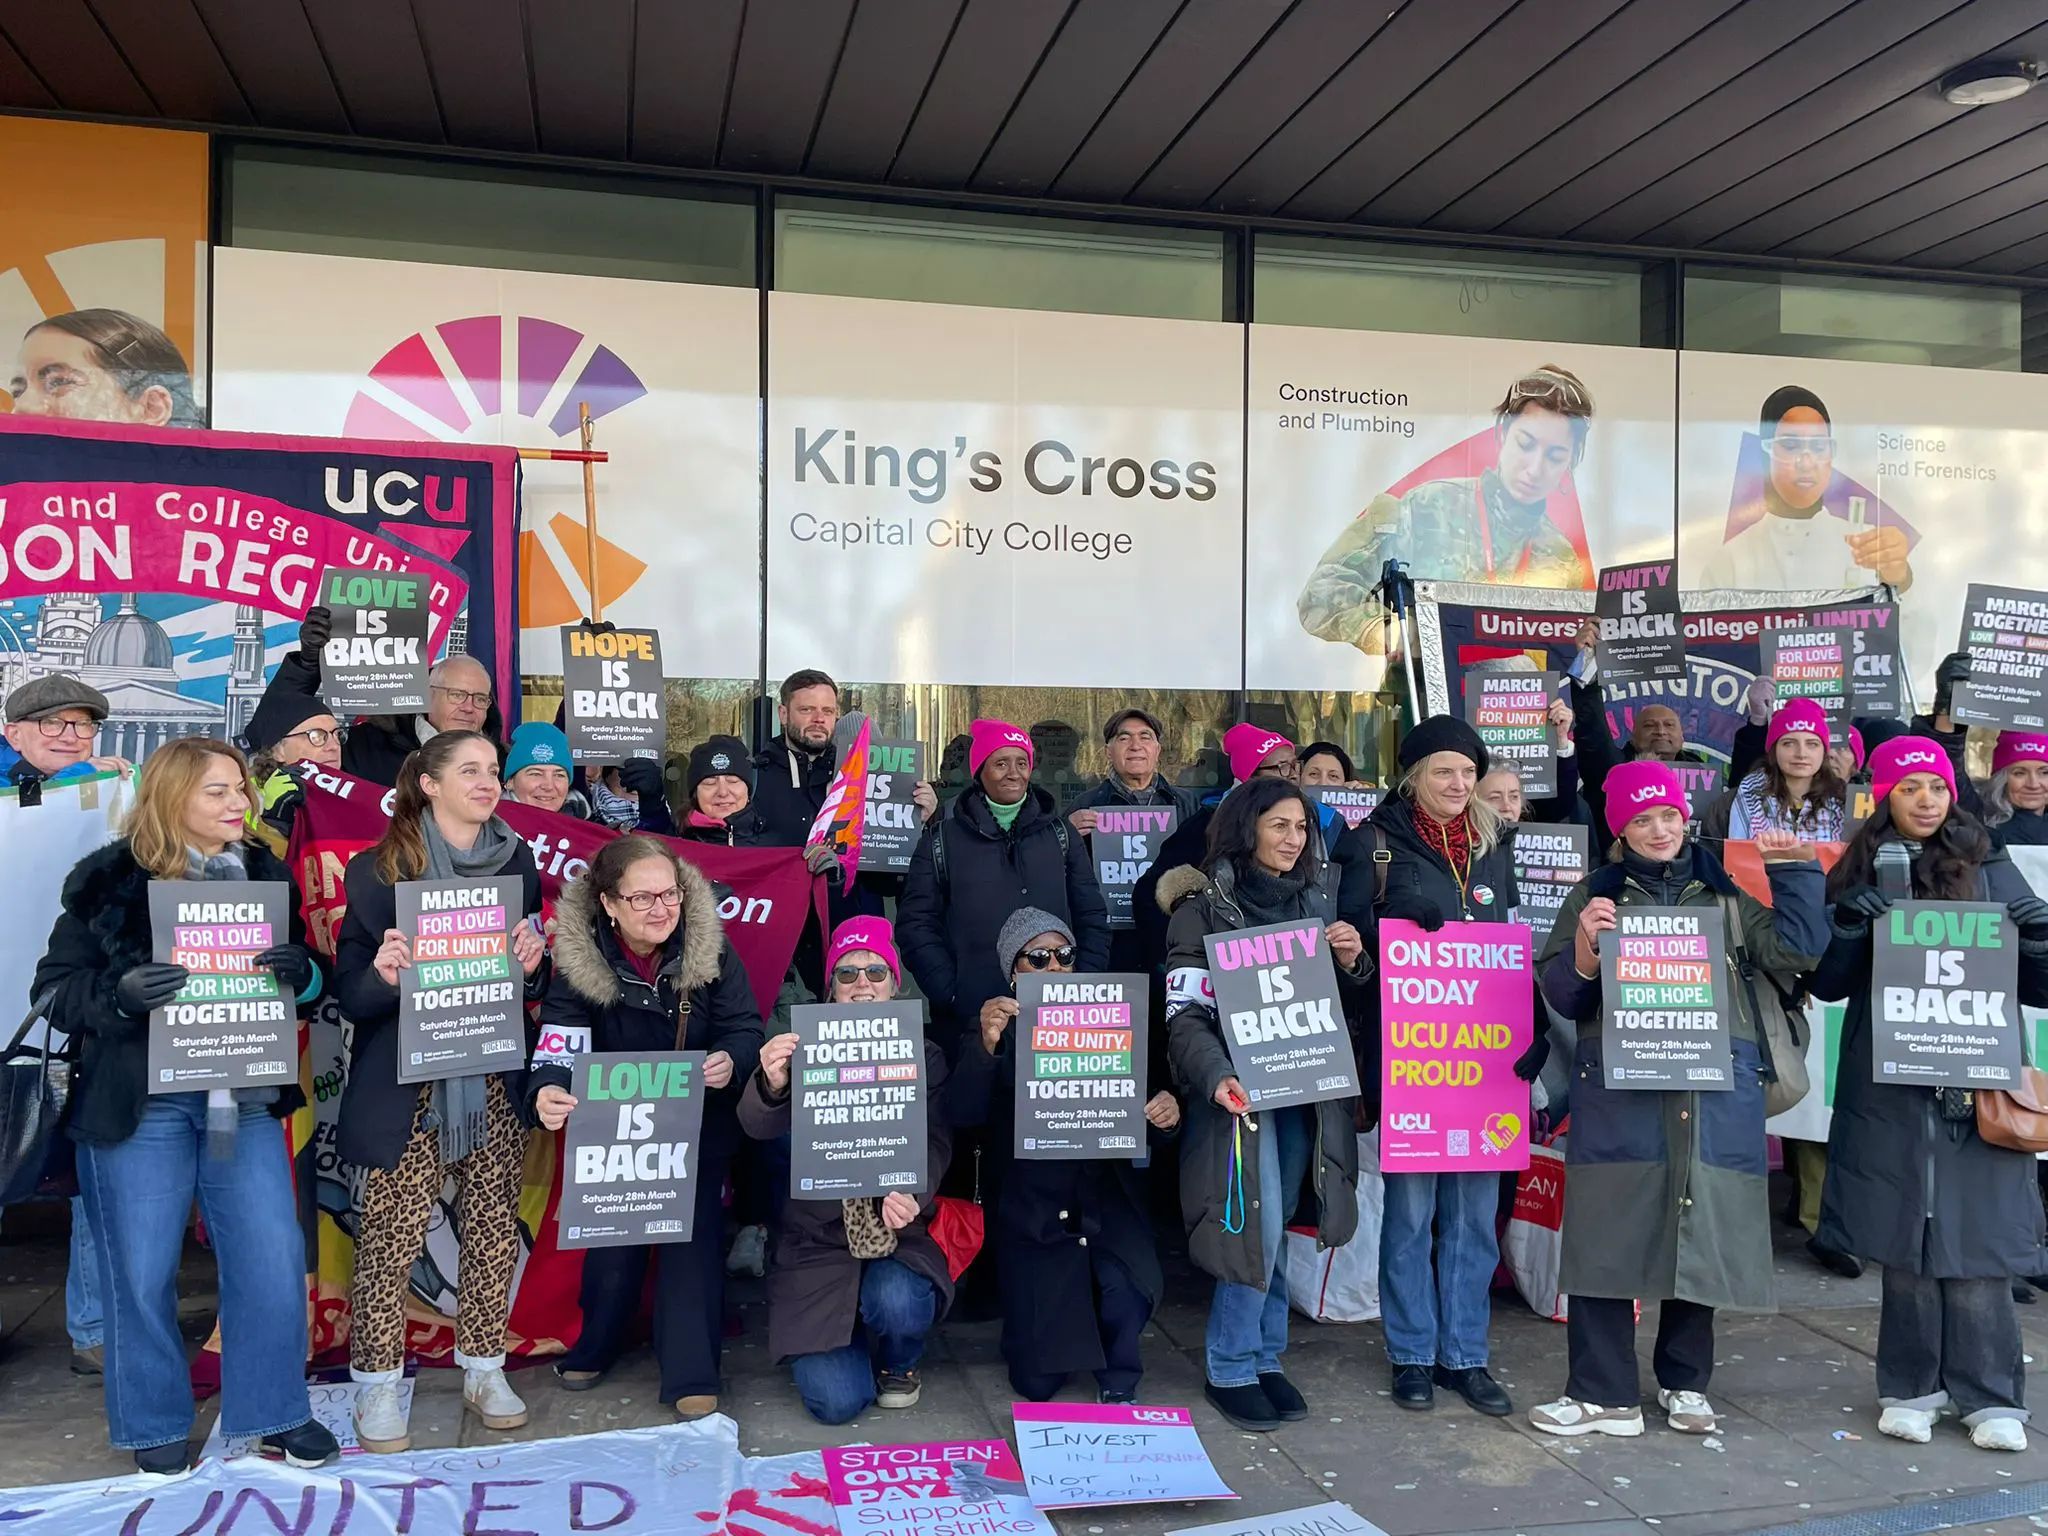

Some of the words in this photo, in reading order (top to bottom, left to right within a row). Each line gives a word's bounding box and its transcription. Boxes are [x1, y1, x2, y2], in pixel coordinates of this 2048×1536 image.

[1279, 383, 1408, 406] Construction
[1279, 412, 1315, 429] and
[1322, 413, 1414, 438] Plumbing
[1878, 433, 1946, 452] Science
[794, 427, 1003, 504] King's
[1024, 440, 1217, 501] Cross
[1878, 461, 1908, 476] and
[1914, 461, 1996, 481] Forensics
[789, 513, 913, 549] Capital
[926, 519, 993, 555] City
[1004, 522, 1133, 561] College
[43, 492, 117, 520] and
[156, 492, 309, 546] College
[346, 536, 450, 608] Unin
[1603, 565, 1671, 592] UNITY
[329, 576, 417, 608] LOVE
[1622, 591, 1647, 614] IS
[356, 609, 387, 634] IS
[1600, 613, 1676, 641] BACK
[1683, 615, 1759, 641] ollege
[1972, 612, 2048, 635] TOGETHE
[570, 632, 654, 660] HOPE
[1778, 633, 1836, 647] MARCH
[324, 637, 420, 666] BACK
[1780, 652, 1802, 663] FOR
[1806, 649, 1838, 660] LOVE.
[1968, 646, 2025, 663] AGAINST
[602, 660, 629, 688] IS
[1777, 666, 1798, 678] FOR
[1803, 666, 1839, 678] UNITY.
[1970, 660, 1997, 674] FAR
[2000, 663, 2043, 678] RIGHT
[347, 682, 374, 690] Central
[1484, 679, 1542, 692] MARCH
[1779, 683, 1800, 695] FOR
[1805, 681, 1838, 693] HOPE.
[573, 690, 659, 719] BACK
[1484, 697, 1506, 708] FOR
[1511, 695, 1543, 707] LOVE.
[1480, 711, 1502, 723] FOR
[1507, 713, 1543, 725] UNITY.
[1482, 730, 1505, 741] FOR
[1509, 728, 1542, 740] HOPE.
[848, 744, 916, 773] OVE
[1321, 791, 1376, 806] MARCH
[864, 802, 914, 828] ACK
[1096, 812, 1170, 832] UNITY
[1123, 835, 1147, 859] IS
[1514, 834, 1572, 850] MARCH
[1513, 850, 1581, 867] OGETHER
[421, 887, 498, 910] MARCH
[178, 903, 264, 922] MARCH
[422, 917, 453, 935] FOR
[457, 910, 500, 931] LOVE.
[1623, 917, 1698, 935] MARCH
[1891, 910, 2002, 948] LOVE
[180, 930, 214, 948] FOR
[219, 927, 267, 945] LOVE.
[417, 939, 448, 956] FOR
[452, 937, 503, 955] UNITY.
[1215, 927, 1318, 971] UNITY
[1388, 940, 1430, 967] ON
[1437, 943, 1524, 970] STRIKE
[1625, 941, 1656, 957] FOR
[1660, 940, 1703, 956] LOVE.
[176, 952, 211, 970] FOR
[1925, 950, 1965, 986] IS
[423, 966, 454, 984] FOR
[459, 961, 504, 980] HOPE.
[1621, 962, 1651, 978] FOR
[1656, 964, 1707, 982] UNITY.
[181, 978, 216, 997] FOR
[222, 977, 273, 994] HOPE.
[1042, 984, 1123, 1003] MARCH
[1258, 965, 1294, 1004] IS
[1388, 978, 1479, 1005] TODAY
[412, 982, 513, 1011] TOGETHER
[1626, 988, 1656, 1004] FOR
[1661, 988, 1708, 1003] HOPE.
[1883, 986, 2007, 1027] BACK
[164, 1002, 285, 1025] TOGETHER
[1042, 1010, 1074, 1026] FOR
[1080, 1007, 1125, 1024] LOVE.
[1230, 998, 1337, 1046] BACK
[1614, 1011, 1718, 1029] TOGETHER
[818, 1018, 898, 1040] MARCH
[1390, 1022, 1447, 1049] UCU
[1453, 1023, 1511, 1050] AND
[1894, 1032, 1939, 1044] Saturday
[1941, 1034, 1964, 1043] 28th
[1966, 1036, 1998, 1045] March
[1037, 1031, 1069, 1047] FOR
[1074, 1032, 1127, 1050] UNITY.
[1909, 1043, 1945, 1054] Central
[1947, 1045, 1984, 1055] London
[187, 1048, 225, 1057] Central
[228, 1046, 263, 1055] London
[804, 1040, 914, 1064] TOGETHER
[806, 1071, 834, 1083] LOVE
[843, 1069, 873, 1080] HOPE
[881, 1067, 914, 1078] UNITY
[1040, 1057, 1071, 1074] FOR
[1077, 1055, 1126, 1072] HOPE.
[1265, 1063, 1295, 1073] Central
[1297, 1058, 1326, 1068] London
[1390, 1060, 1483, 1086] PROUD
[587, 1062, 692, 1100] LOVE
[1027, 1080, 1135, 1099] TOGETHER
[803, 1088, 880, 1108] AGAINST
[883, 1086, 916, 1103] THE
[616, 1103, 655, 1140] IS
[814, 1107, 849, 1125] FAR
[853, 1104, 905, 1121] RIGHT
[575, 1143, 689, 1184] BACK
[825, 1151, 859, 1161] Central
[861, 1148, 894, 1158] London
[594, 1204, 628, 1214] Central
[630, 1202, 662, 1212] London
[1029, 1426, 1158, 1449] INVEST
[840, 1445, 1000, 1468] STOLEN:
[1066, 1452, 1094, 1461] IN
[844, 1466, 941, 1486] OUR
[1031, 1475, 1098, 1486] NOT
[1131, 1474, 1160, 1483] IN
[848, 1484, 938, 1505] PAY
[119, 1477, 639, 1536] UNITED
[858, 1501, 1010, 1524] Support
